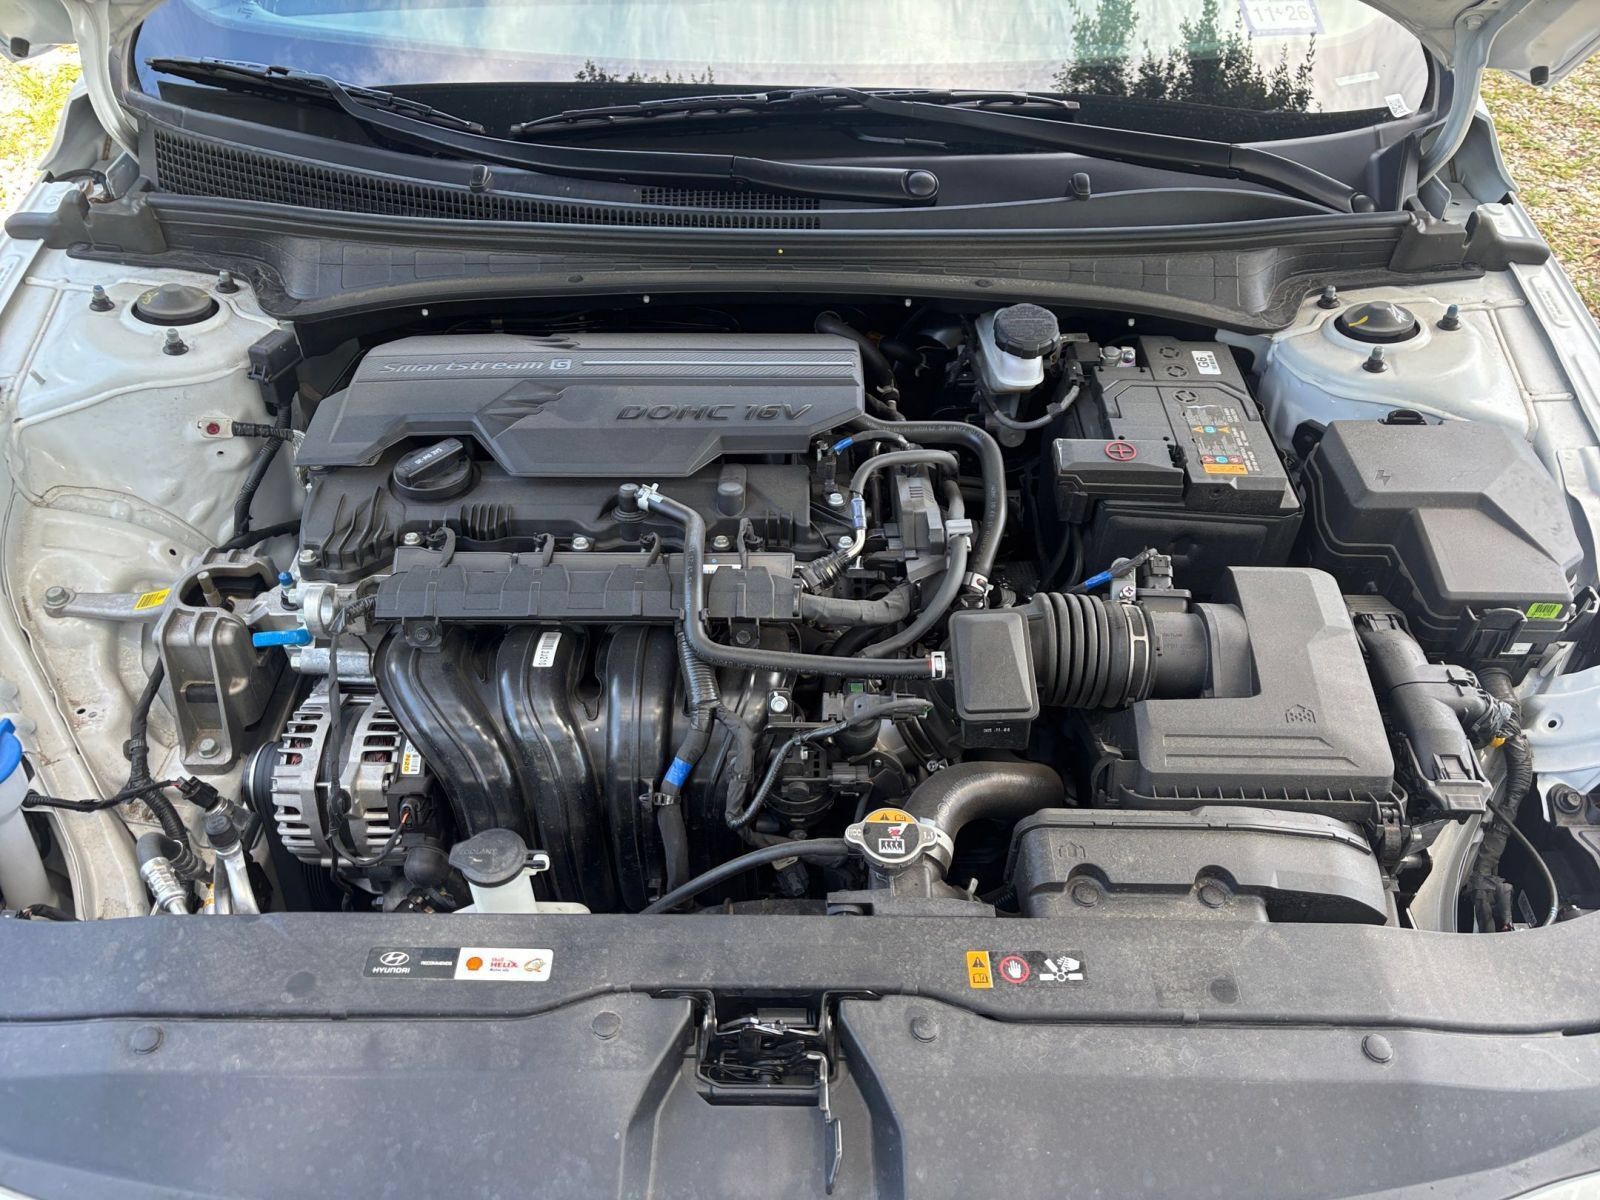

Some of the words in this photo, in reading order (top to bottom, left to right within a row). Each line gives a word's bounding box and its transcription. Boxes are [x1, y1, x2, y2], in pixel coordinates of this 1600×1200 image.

[379, 359, 544, 373] Smartstream
[616, 403, 736, 420] DOHC
[744, 403, 813, 420] 16V
[490, 960, 518, 968] HELIX
[372, 966, 411, 974] HYUNDAI
